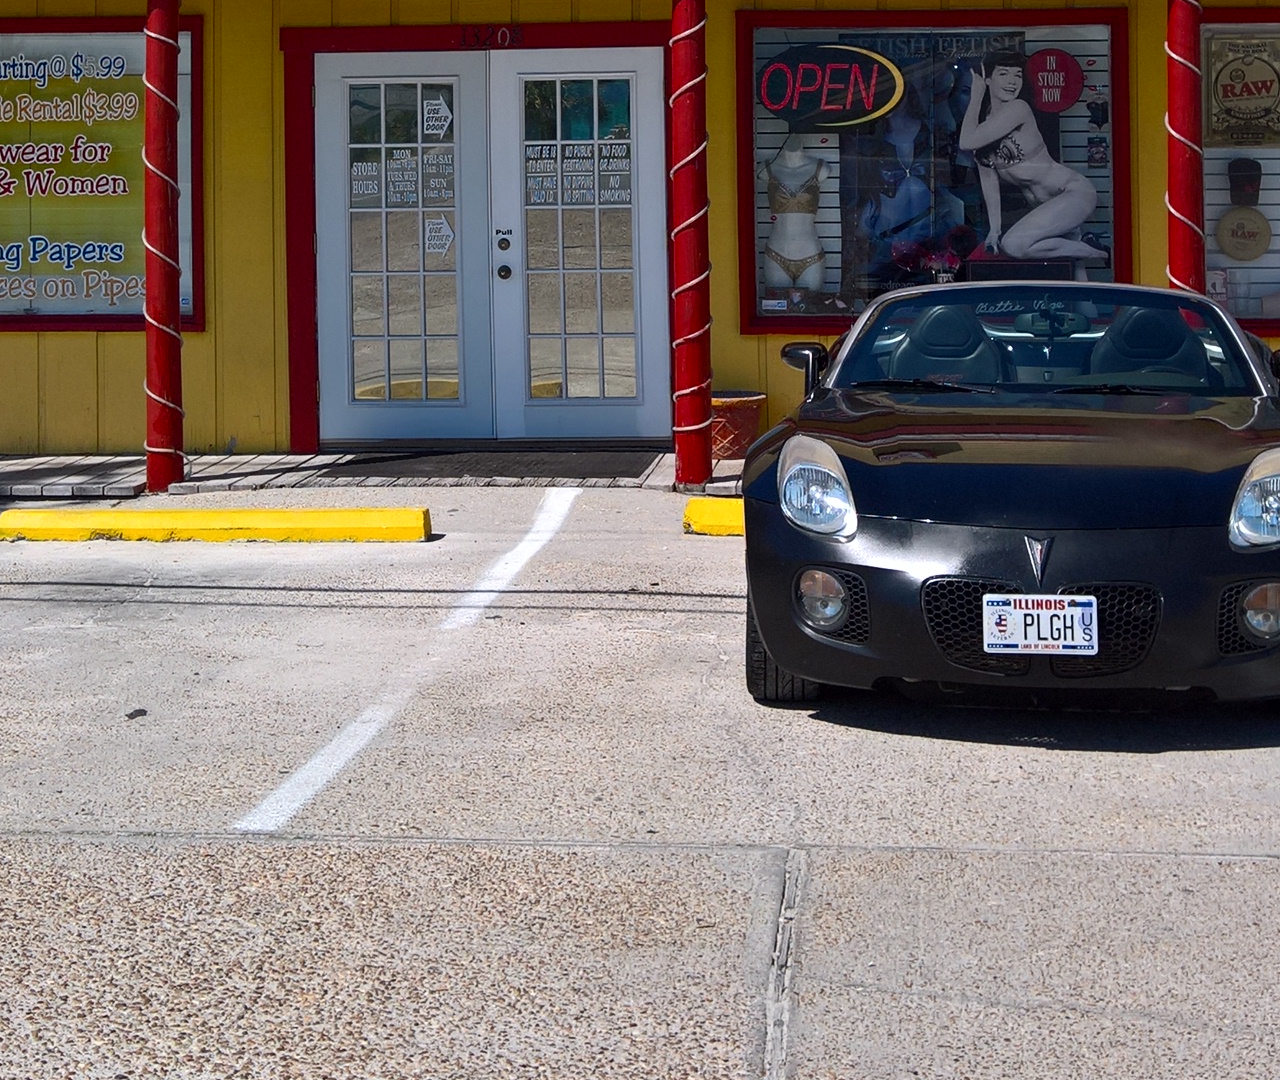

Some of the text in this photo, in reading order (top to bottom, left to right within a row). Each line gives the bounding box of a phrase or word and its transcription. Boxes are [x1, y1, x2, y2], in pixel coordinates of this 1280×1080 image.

[937, 36, 1020, 53] FETISH
[71, 51, 126, 82] $5.99
[1047, 56, 1056, 70] IN
[1038, 72, 1065, 86] STORE
[761, 63, 879, 111] OPEN
[1220, 79, 1275, 99] RAW
[1042, 88, 1061, 102] NOW
[16, 94, 82, 122] Rental
[83, 88, 139, 125] $3.99
[70, 135, 112, 164] for
[393, 149, 412, 159] MON
[525, 145, 542, 158] MUST
[542, 146, 550, 158] BE
[565, 145, 592, 157] NO PUBLIC
[601, 145, 627, 157] NO FOOD
[352, 163, 378, 175] STORE
[536, 160, 555, 172] ENTER
[608, 159, 630, 170] DRINKS
[23, 170, 129, 198] Women
[353, 181, 378, 194] HOURS
[430, 178, 447, 188] SUN
[609, 176, 620, 188] NO
[600, 189, 630, 201] SMOKING
[1231, 229, 1259, 240] RAW
[28, 235, 124, 270] Papers
[427, 242, 447, 250] DOOR
[42, 276, 76, 299] on
[82, 269, 146, 306] Pipes
[976, 300, 1025, 314] Bettie
[1013, 599, 1066, 610] ILLINOIS
[990, 608, 1013, 616] ILLINOIS
[1023, 613, 1075, 641] PLGH
[990, 631, 1015, 640] VETERAN
